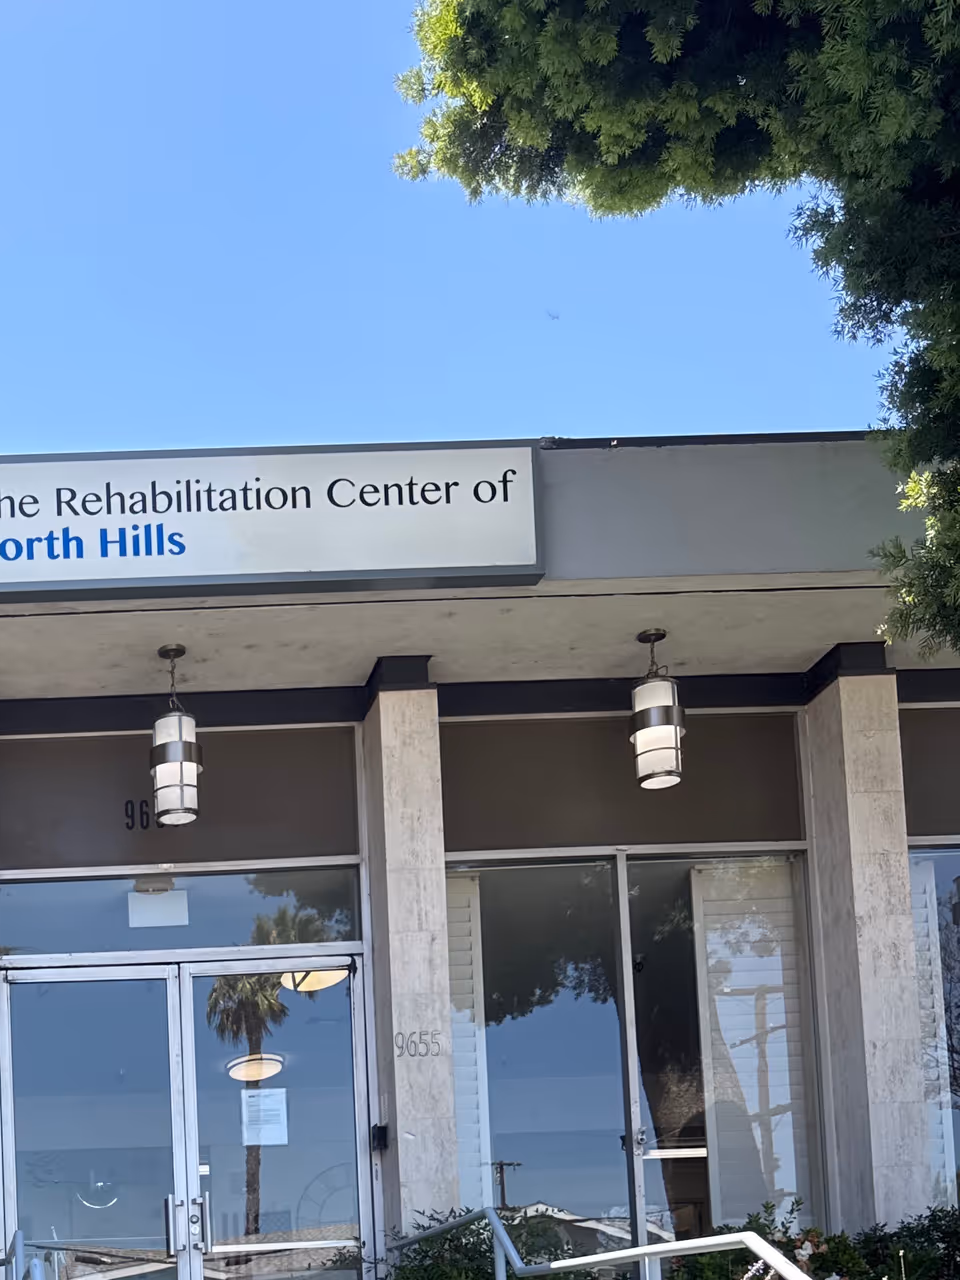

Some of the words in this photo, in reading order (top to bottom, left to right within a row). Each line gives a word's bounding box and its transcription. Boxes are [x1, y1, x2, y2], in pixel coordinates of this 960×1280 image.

[56, 477, 312, 517] Rehabilitation
[326, 475, 460, 508] Center
[472, 469, 517, 504] of
[99, 523, 186, 558] Hills
[394, 1029, 442, 1058] 9655
